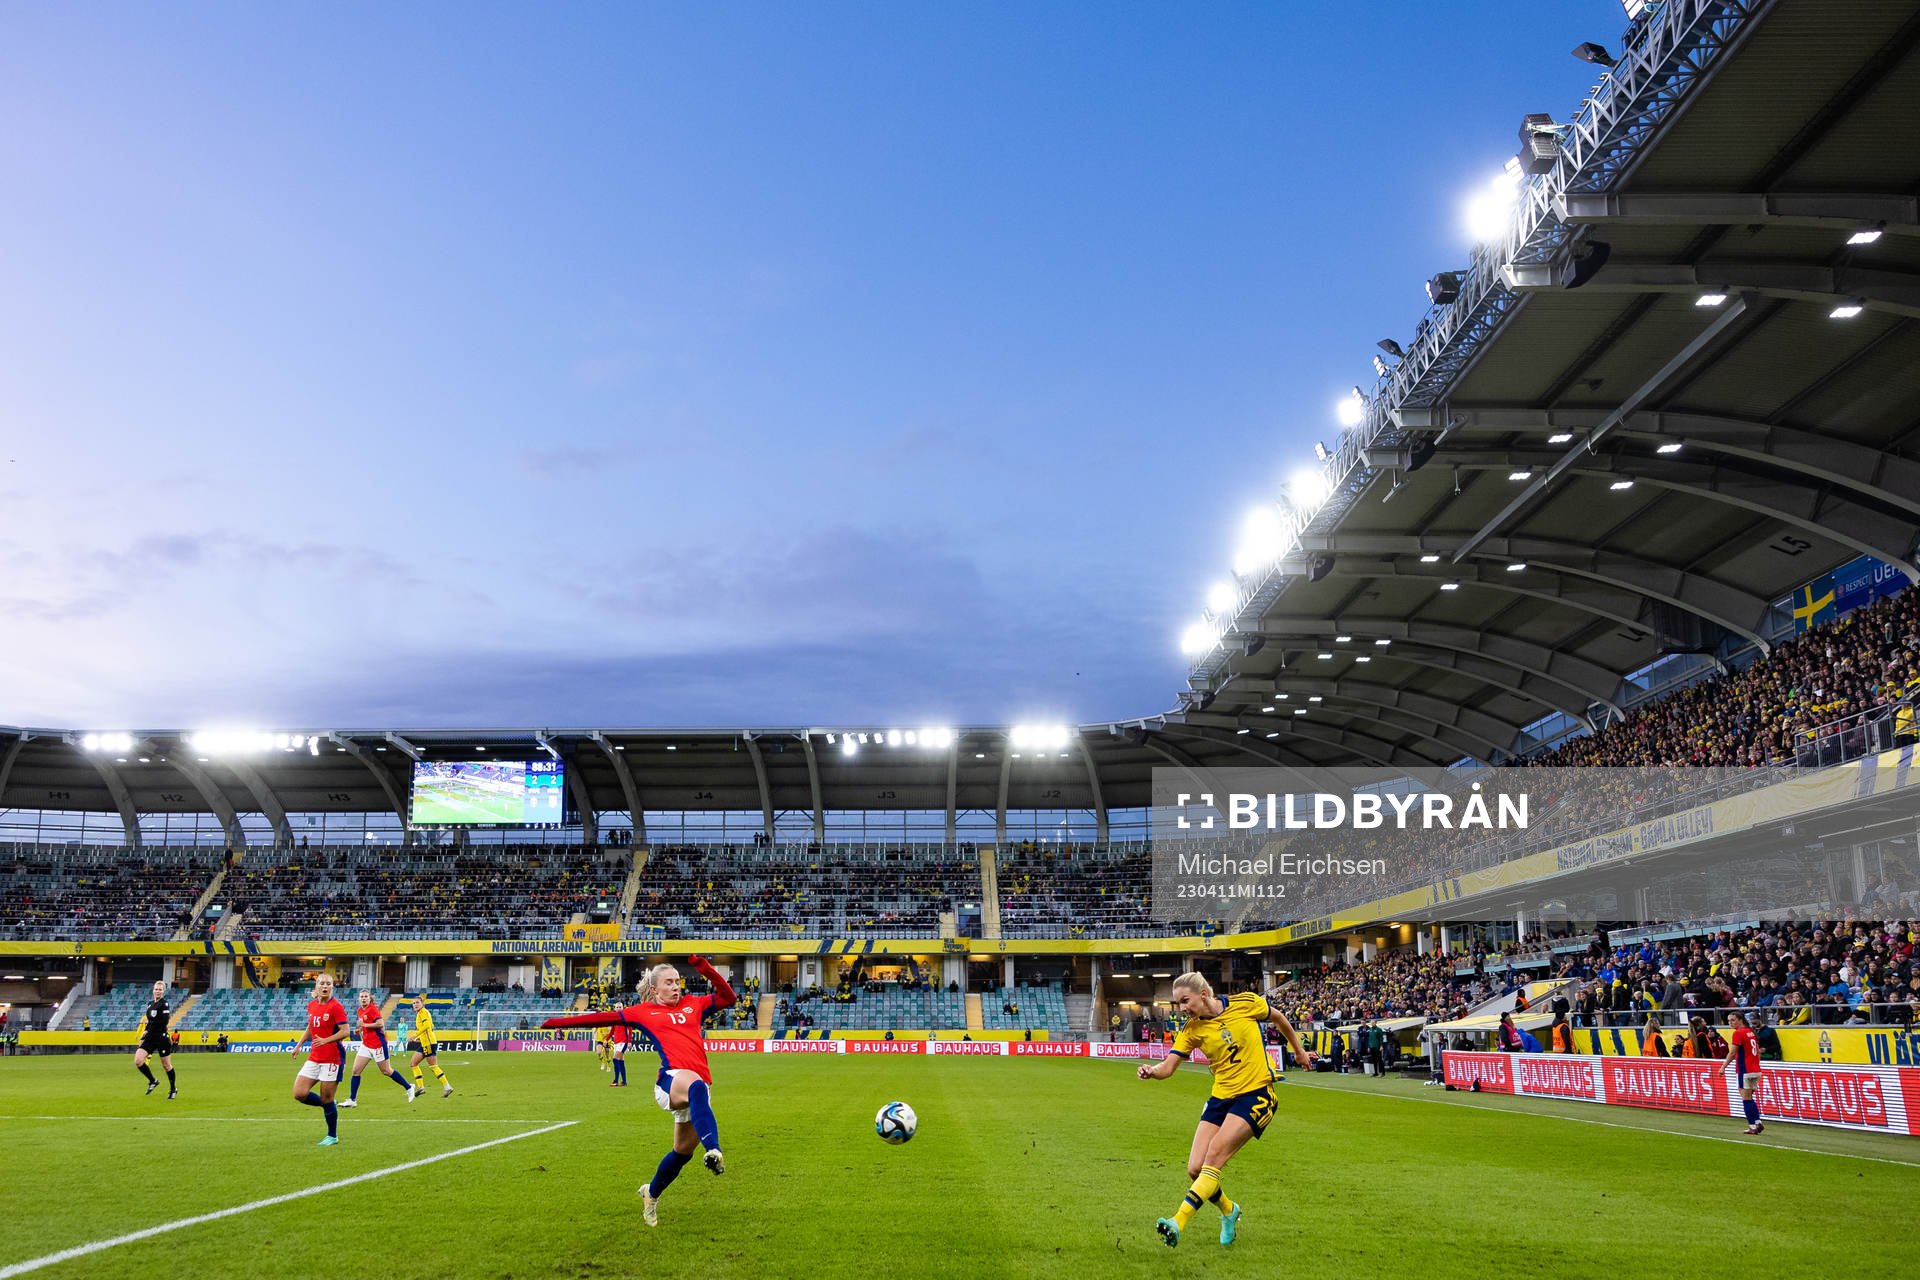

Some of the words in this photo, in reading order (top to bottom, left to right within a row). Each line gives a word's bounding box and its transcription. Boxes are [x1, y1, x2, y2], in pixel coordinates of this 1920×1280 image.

[1769, 534, 1812, 557] L5
[1874, 563, 1900, 583] UEF
[1845, 574, 1869, 593] RESPECT
[531, 775, 538, 785] 2
[550, 775, 557, 785] 2
[328, 793, 352, 801] H3
[877, 791, 896, 799] J3
[1041, 790, 1061, 798] J2
[1640, 818, 1676, 850] GAMLA
[1677, 806, 1714, 840] ULLEVI
[492, 941, 583, 953] NATIONALARENAN
[592, 941, 627, 953] GAMLA
[630, 941, 663, 953] ULLEVI
[313, 1016, 320, 1028] 15
[667, 1013, 686, 1025] 13
[521, 1041, 567, 1052] Folksam
[703, 1041, 756, 1051] AUHAUS
[772, 1041, 838, 1051] BAUHAUS
[854, 1042, 919, 1053] BAUHAUS
[935, 1042, 1000, 1053] BAUHAUS
[1017, 1043, 1082, 1054] BAUHAUS
[1097, 1044, 1139, 1056] BAUHAUS
[1750, 1039, 1757, 1057] 8
[1865, 1033, 1891, 1065] VI
[1227, 1044, 1242, 1064] 2
[328, 1063, 337, 1073] 15
[1449, 1059, 1505, 1085] BAUHAUS
[1519, 1059, 1593, 1092] BAUHAUS
[1613, 1067, 1713, 1102] BAUHAUS
[1762, 1074, 1882, 1117] AUHAUS
[1251, 1096, 1269, 1117] 2
